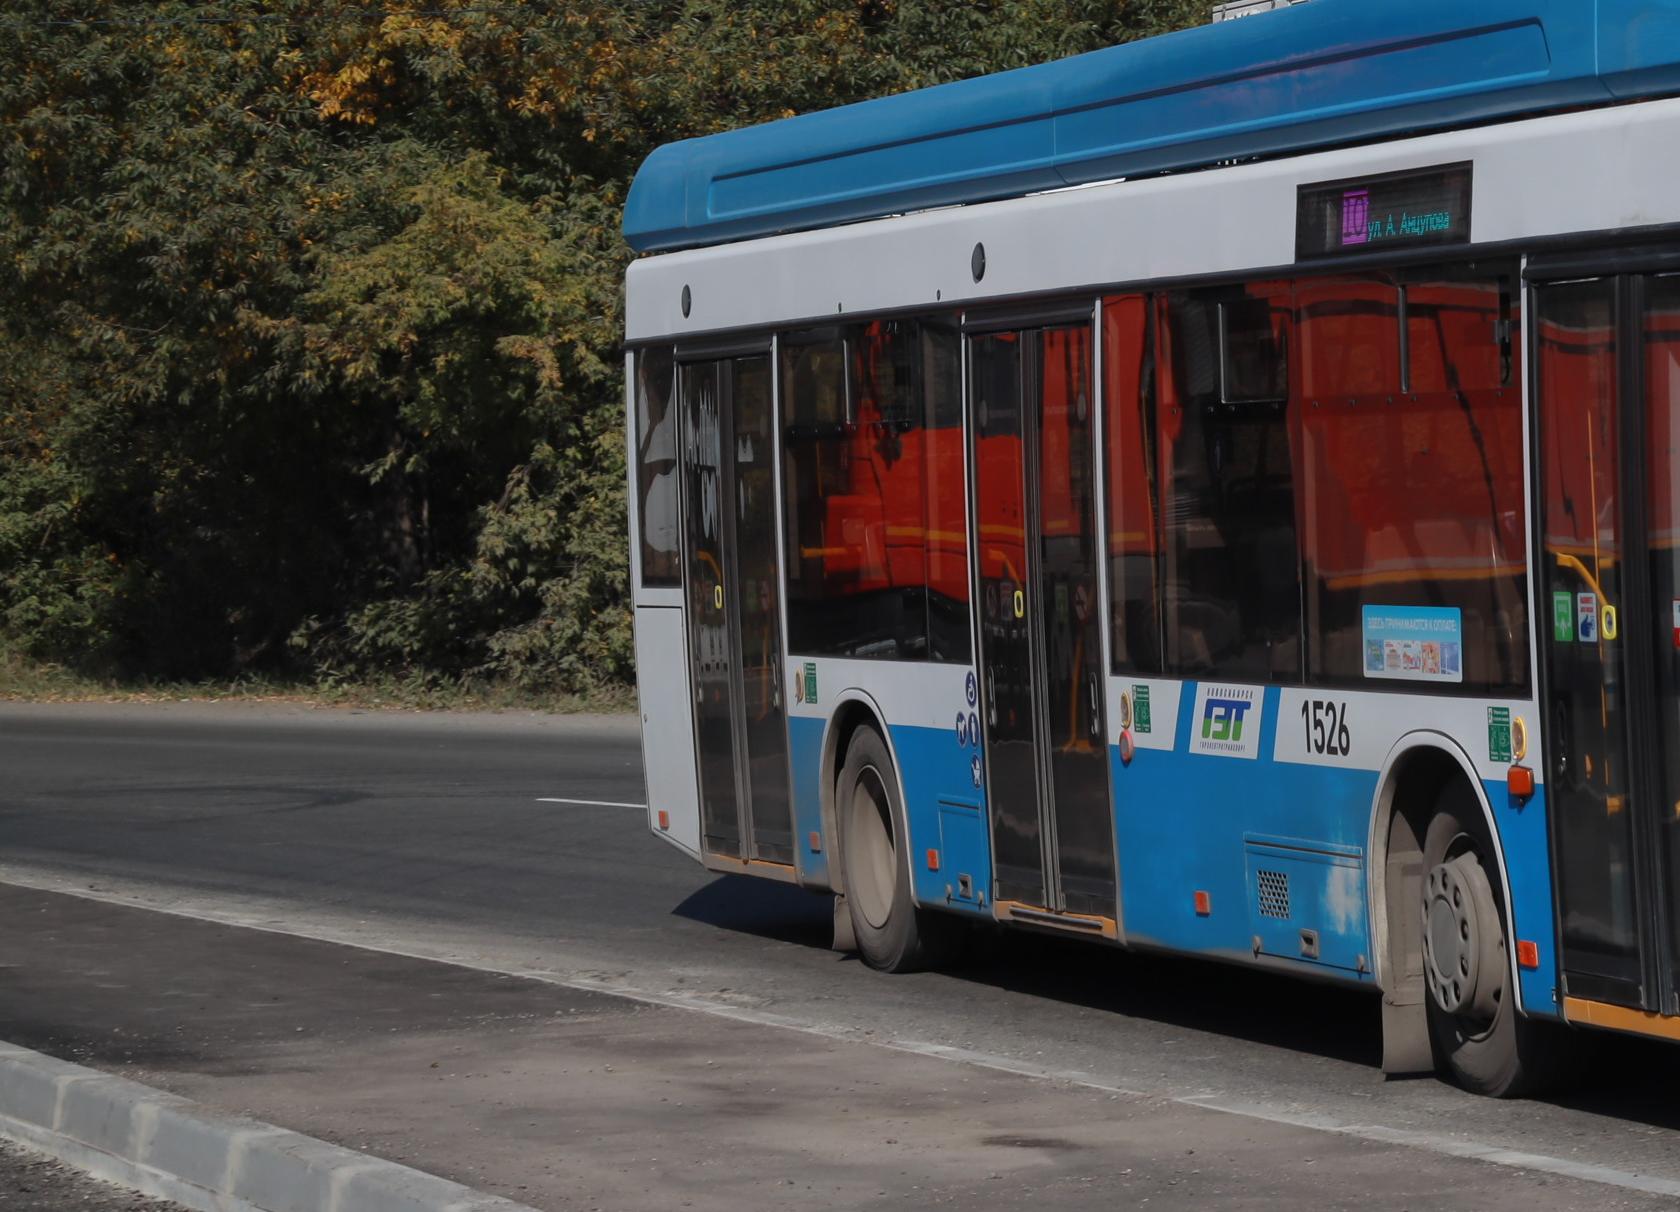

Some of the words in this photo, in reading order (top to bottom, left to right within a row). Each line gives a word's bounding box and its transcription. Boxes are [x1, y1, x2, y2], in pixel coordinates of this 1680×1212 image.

[1400, 212, 1449, 235] Анцупова
[1202, 698, 1252, 742] ГЭТ
[1301, 699, 1351, 757] 1526
